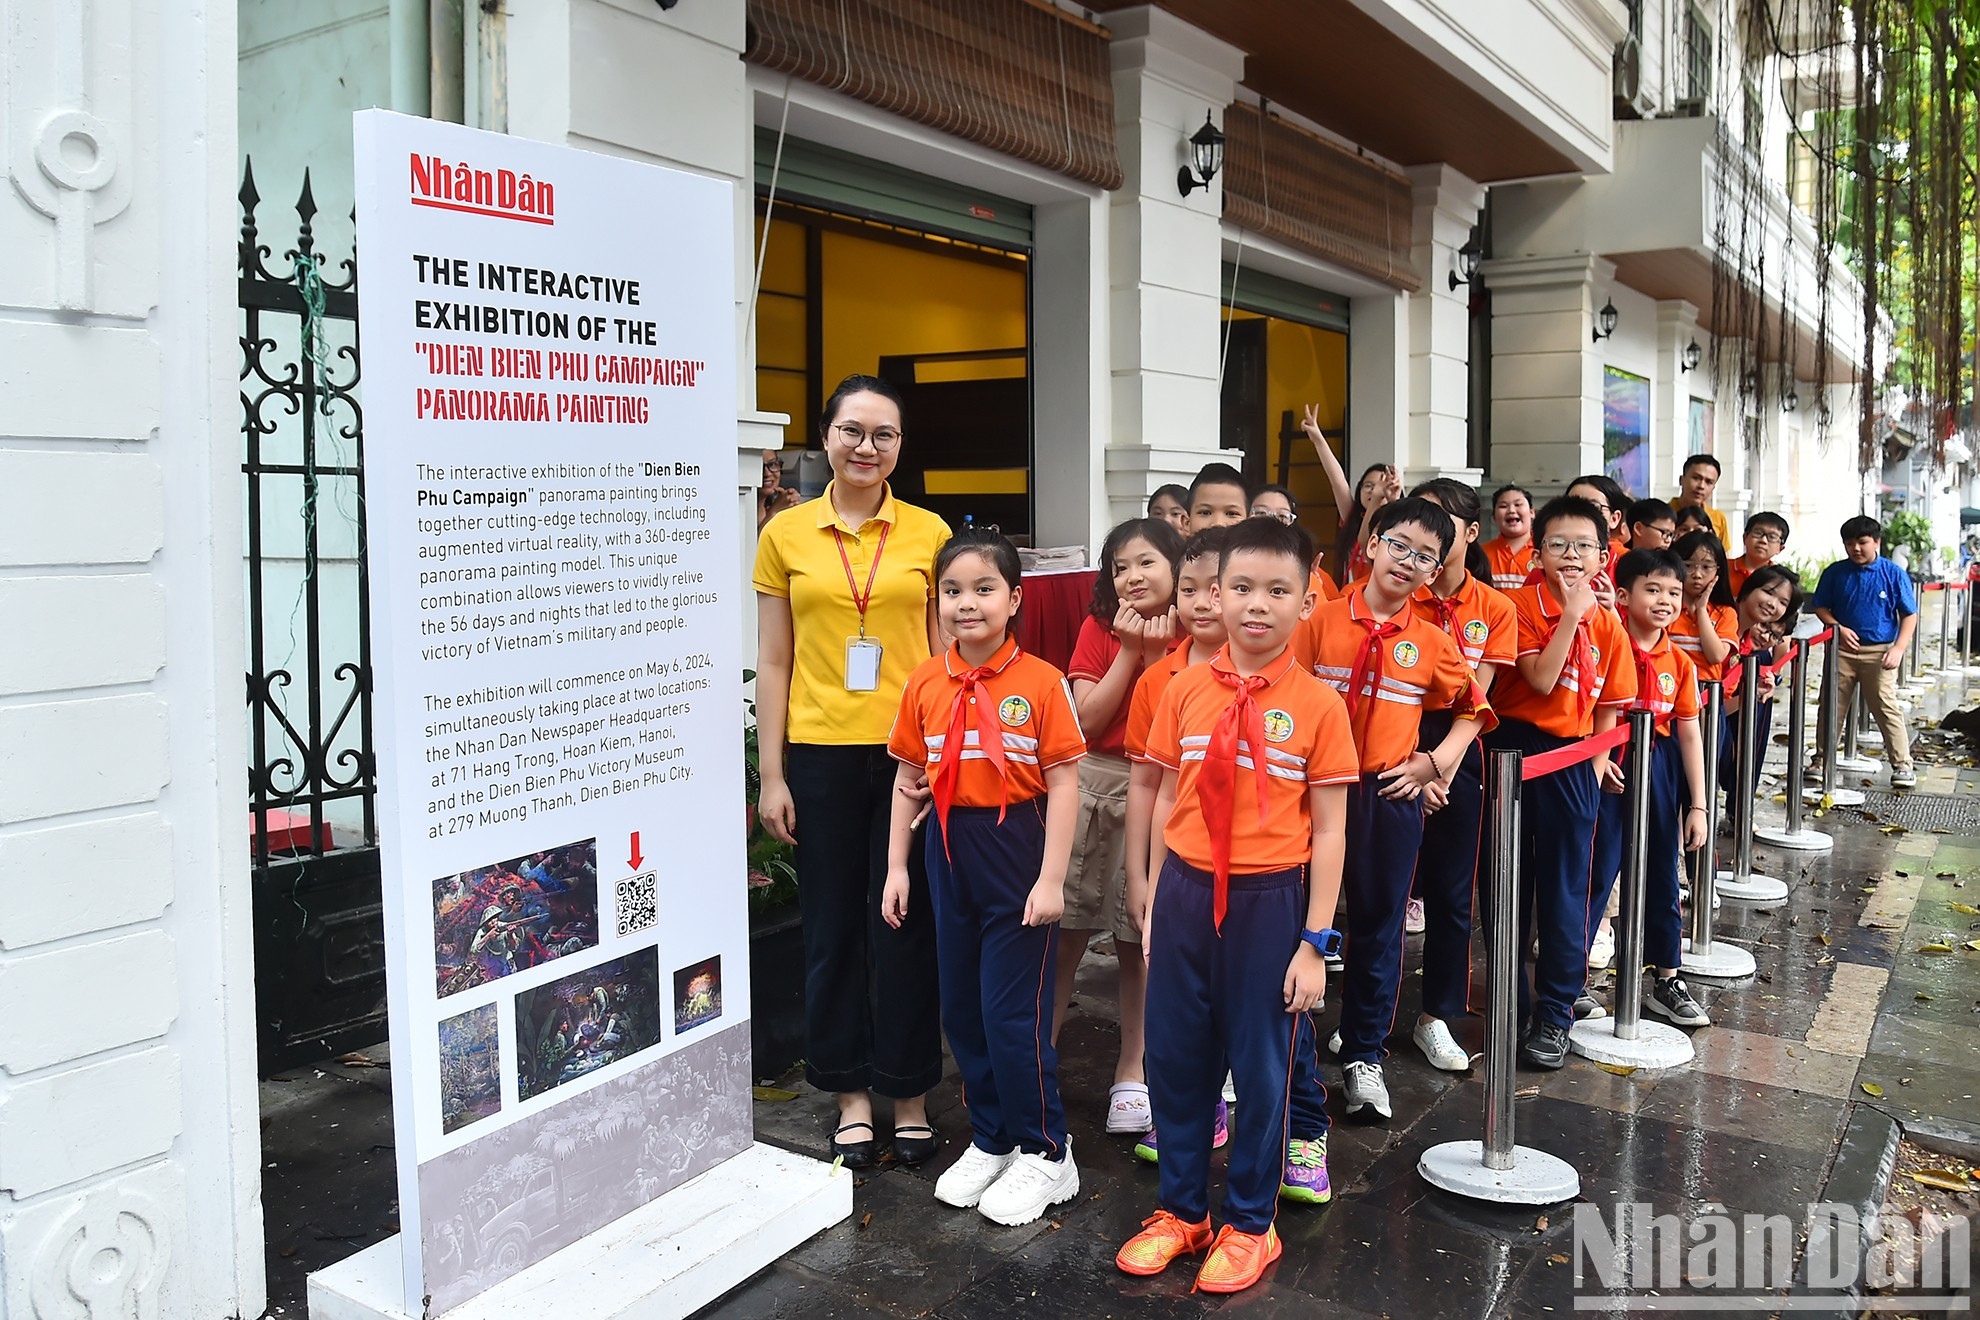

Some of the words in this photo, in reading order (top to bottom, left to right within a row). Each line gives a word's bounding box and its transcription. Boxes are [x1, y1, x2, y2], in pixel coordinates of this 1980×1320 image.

[412, 254, 469, 288] THE
[478, 261, 640, 306] INTERACTIVE
[415, 299, 569, 340] EXHIBITION
[576, 315, 607, 342] OF
[613, 318, 657, 347] THE
[415, 341, 484, 377] "DIEN
[490, 346, 542, 380] BIEN
[548, 350, 589, 382] PHU
[594, 354, 705, 388] CAMPAIGN"
[416, 387, 551, 423] PANORAMA
[556, 393, 649, 425] PAINTING
[415, 463, 445, 481] The
[450, 464, 527, 481] interactive
[531, 463, 596, 479] exhibition
[599, 462, 612, 478] of
[614, 462, 635, 478] the
[638, 461, 671, 477] "Dien
[674, 461, 701, 477] Bien
[417, 489, 448, 507] Phu
[452, 487, 534, 509] Campaign"
[539, 489, 606, 507] panorama
[609, 485, 658, 505] painting
[661, 484, 698, 502] brings
[418, 514, 484, 537] together
[487, 510, 576, 532] cutting-edge
[579, 507, 651, 527] technology,
[654, 505, 706, 523] including
[418, 537, 504, 562] augmented
[507, 534, 553, 553] virtual
[556, 532, 602, 552] reality,
[604, 530, 631, 547] with
[634, 533, 642, 545] a
[644, 527, 711, 545] 360-degree
[420, 566, 496, 589] panorama
[501, 560, 557, 582] painting
[561, 554, 605, 573] model.
[608, 553, 635, 569] This
[638, 551, 678, 569] unique
[420, 588, 512, 610] combination
[516, 583, 562, 601] allows
[564, 580, 615, 596] viewers
[617, 577, 630, 591] to
[632, 572, 670, 591] vividly
[672, 570, 704, 586] relive
[421, 618, 446, 636] the
[450, 614, 468, 633] 56
[472, 613, 506, 633] days
[509, 607, 535, 626] and
[539, 604, 581, 626] nights
[584, 601, 610, 618] that
[613, 597, 632, 614] led
[635, 598, 647, 612] to
[650, 594, 669, 610] the
[672, 591, 718, 612] glorious
[421, 643, 473, 661] victory
[476, 636, 491, 655] of
[567, 625, 617, 643] military
[619, 618, 642, 636] and
[645, 614, 688, 637] people.
[423, 694, 452, 712] The
[456, 685, 525, 707] exhibition
[528, 677, 553, 696] will
[555, 669, 626, 691] commence
[628, 667, 644, 680] on
[646, 661, 670, 678] May
[672, 657, 683, 674] 6,
[685, 653, 714, 671] 2024,
[424, 705, 536, 738] simultaneously
[538, 699, 579, 718] taking
[582, 693, 616, 715] place
[619, 688, 631, 704] at
[633, 687, 655, 701] two
[657, 678, 711, 697] locations:
[425, 745, 451, 764] the
[455, 739, 495, 758] Nhan
[499, 732, 527, 749] Dan
[531, 718, 606, 743] Newspaper
[609, 702, 691, 728] Headquarters
[431, 770, 446, 788] at
[450, 765, 466, 784] 71
[473, 760, 511, 779] Hang
[514, 751, 559, 770] Trong,
[562, 743, 596, 761] Hoan
[599, 736, 635, 753] Kiem,
[638, 725, 676, 745] Hanoi,
[428, 792, 456, 814] and
[460, 789, 484, 807] the
[488, 782, 521, 801] Dien
[525, 775, 556, 792] Bien
[559, 767, 585, 784] Phu
[587, 758, 631, 777] Victory
[634, 746, 684, 768] Museum
[428, 822, 444, 839] at
[448, 813, 474, 835] 279
[479, 805, 527, 827] Muong
[530, 791, 577, 814] Thanh,
[580, 786, 609, 803] Dien
[612, 778, 640, 795] Bien
[643, 771, 666, 788] Phu
[669, 765, 694, 781] City.
